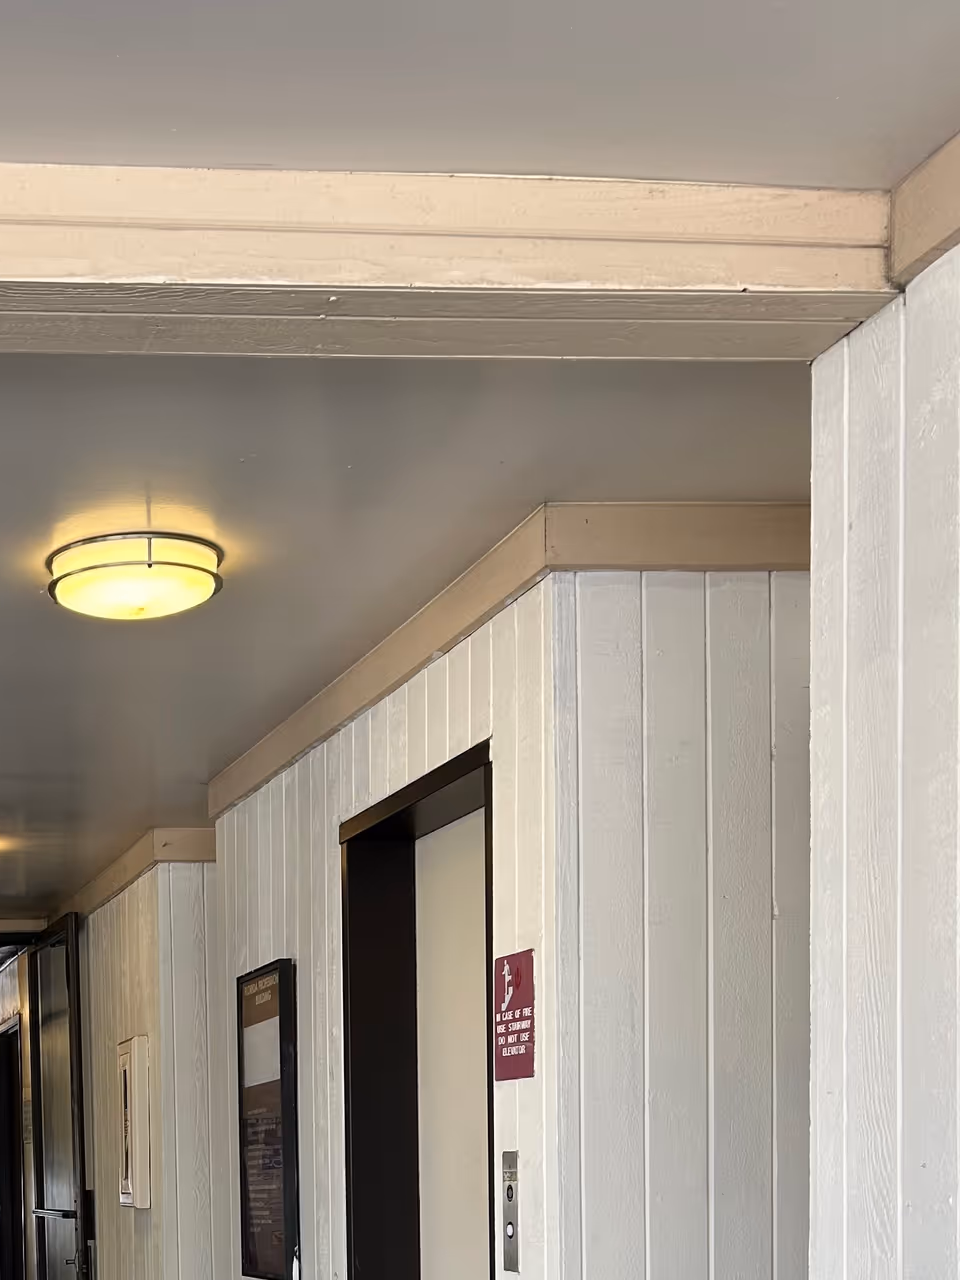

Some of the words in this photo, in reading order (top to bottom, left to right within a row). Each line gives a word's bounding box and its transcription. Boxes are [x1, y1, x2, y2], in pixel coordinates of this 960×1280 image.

[496, 1013, 501, 1022] IN
[502, 1010, 514, 1020] CASE
[515, 1009, 521, 1018] OF
[522, 1007, 532, 1016] FIRE
[497, 1024, 506, 1033] USE
[508, 1020, 531, 1031] STAIRWAY
[498, 1036, 505, 1045] DO
[507, 1034, 518, 1043] NOT
[520, 1032, 530, 1041] USE
[502, 1045, 525, 1056] ELEVATOR
